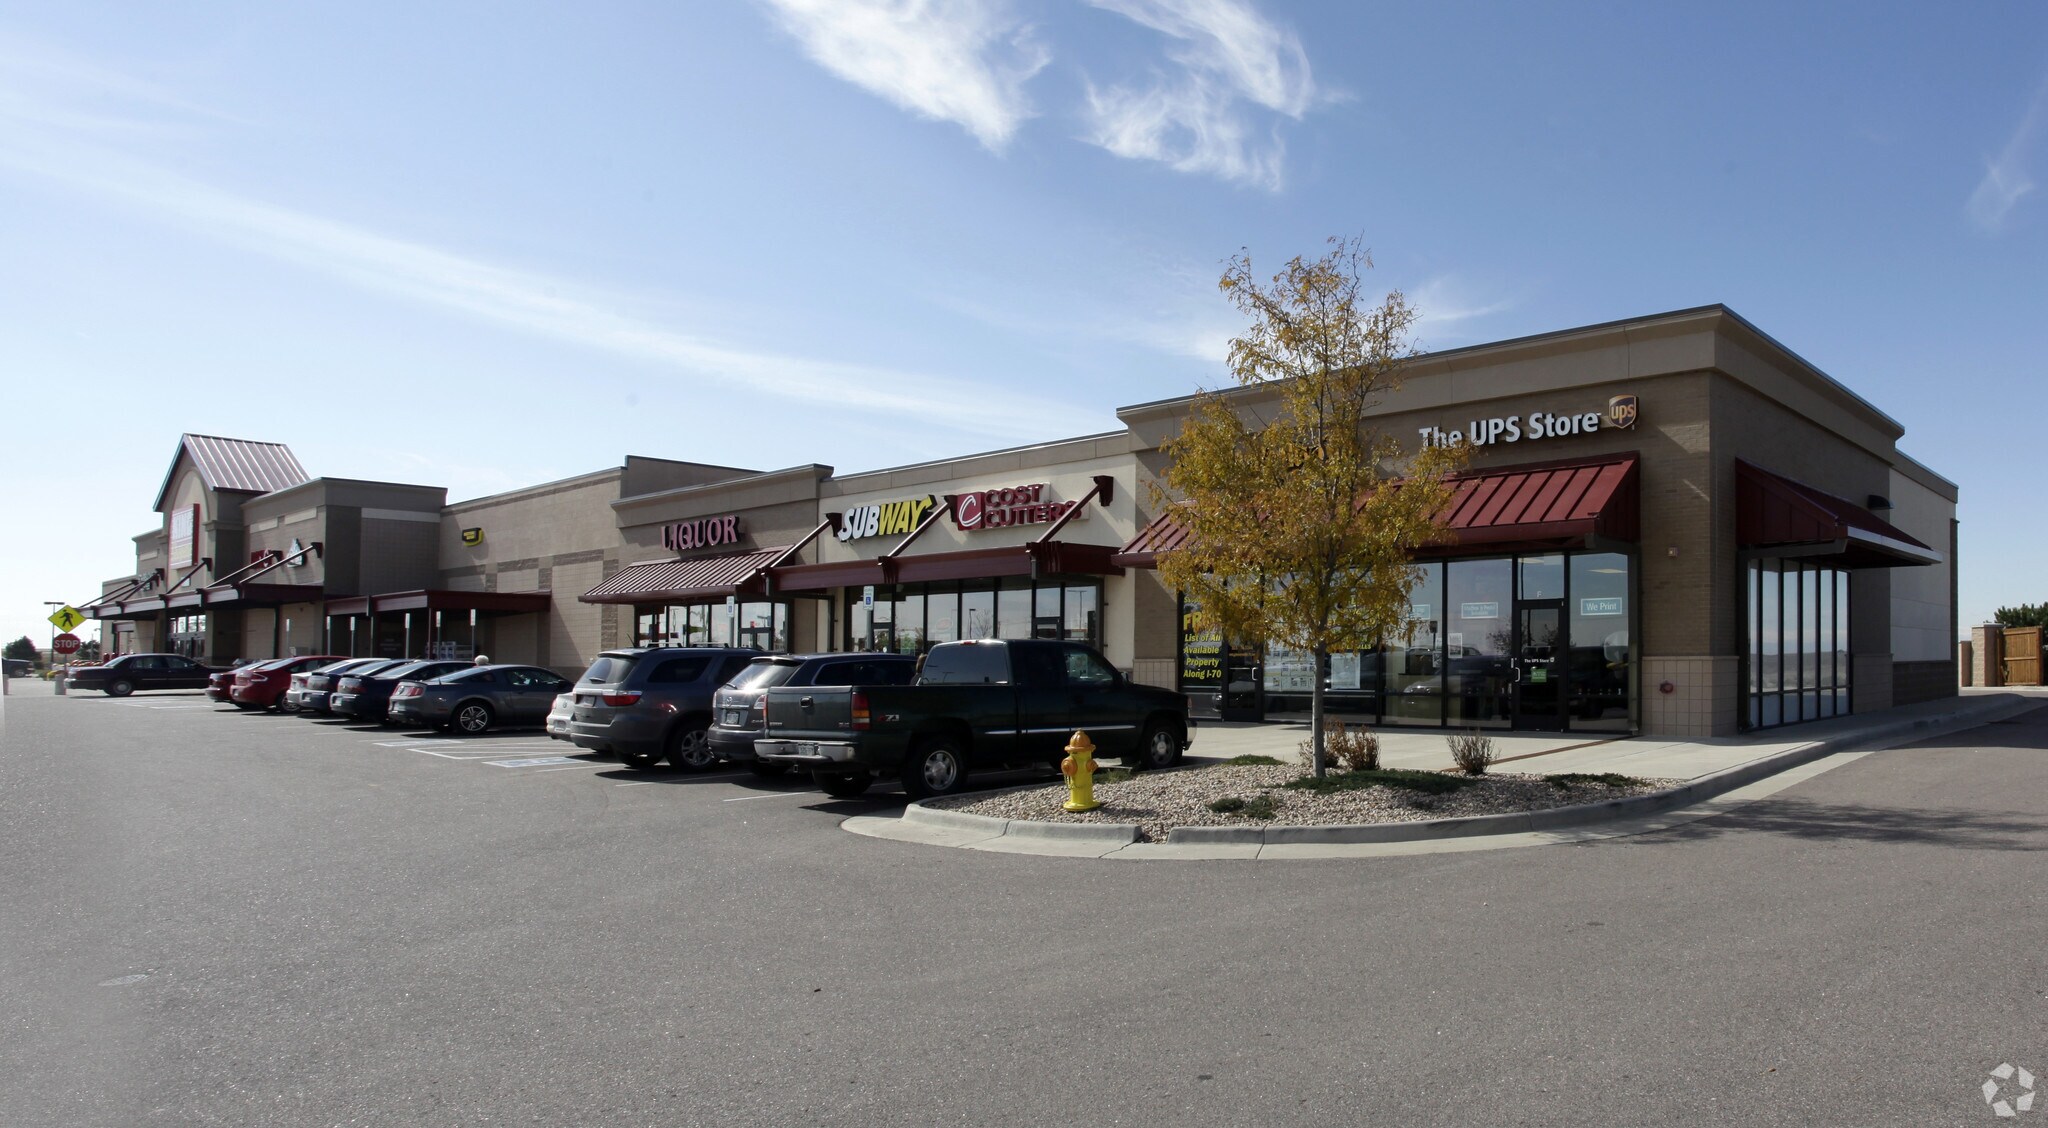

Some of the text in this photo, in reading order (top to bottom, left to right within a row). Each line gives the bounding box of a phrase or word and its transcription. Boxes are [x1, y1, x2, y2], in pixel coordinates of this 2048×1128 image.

[1611, 403, 1635, 424] ups
[1418, 412, 1599, 450] The UPS Store
[985, 483, 1044, 508] COST
[837, 496, 933, 541] SUBWAY
[661, 515, 738, 551] LIQUOR
[1586, 601, 1617, 611] We Print
[1184, 633, 1199, 642] List
[54, 639, 79, 649] STOP
[1183, 645, 1220, 654] Available
[1186, 657, 1220, 667] Property
[1183, 669, 1222, 680] Along I-70
